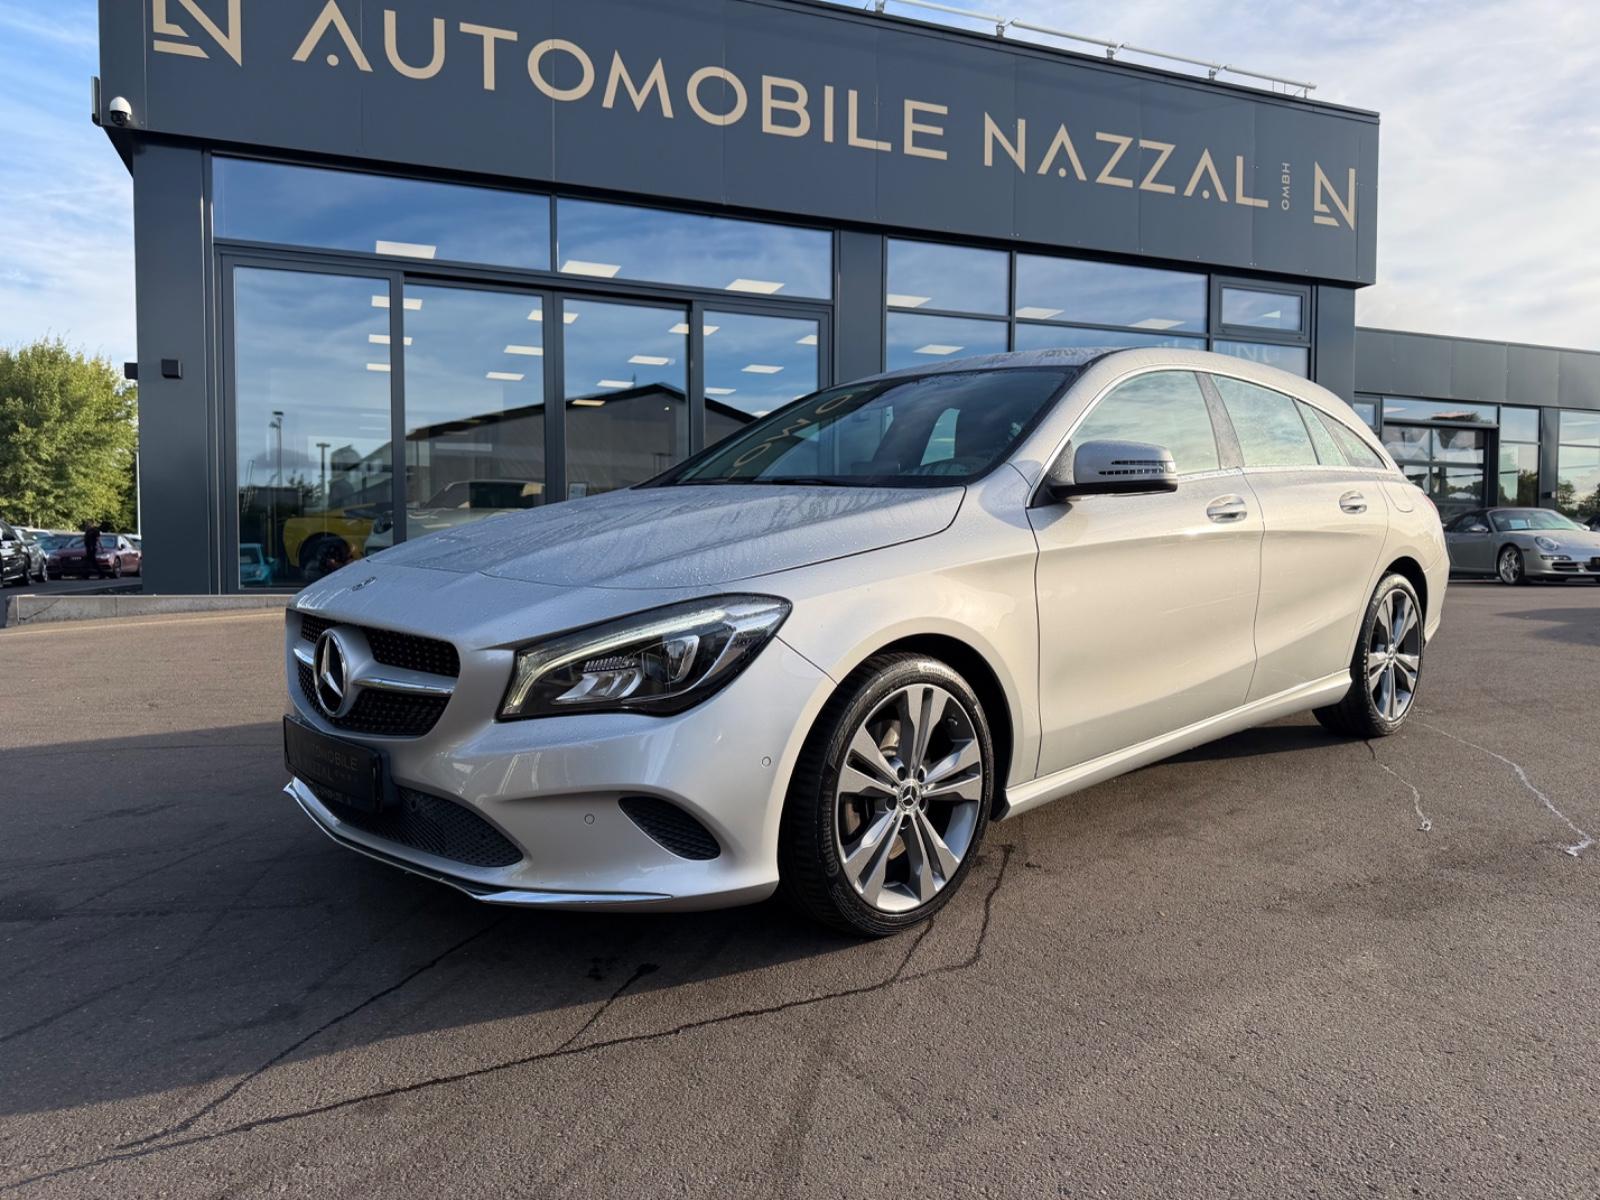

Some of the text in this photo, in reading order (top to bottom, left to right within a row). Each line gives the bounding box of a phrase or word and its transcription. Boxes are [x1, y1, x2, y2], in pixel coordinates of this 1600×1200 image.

[292, 0, 1291, 211] AUTOMOBILE NAZZAL GMBH
